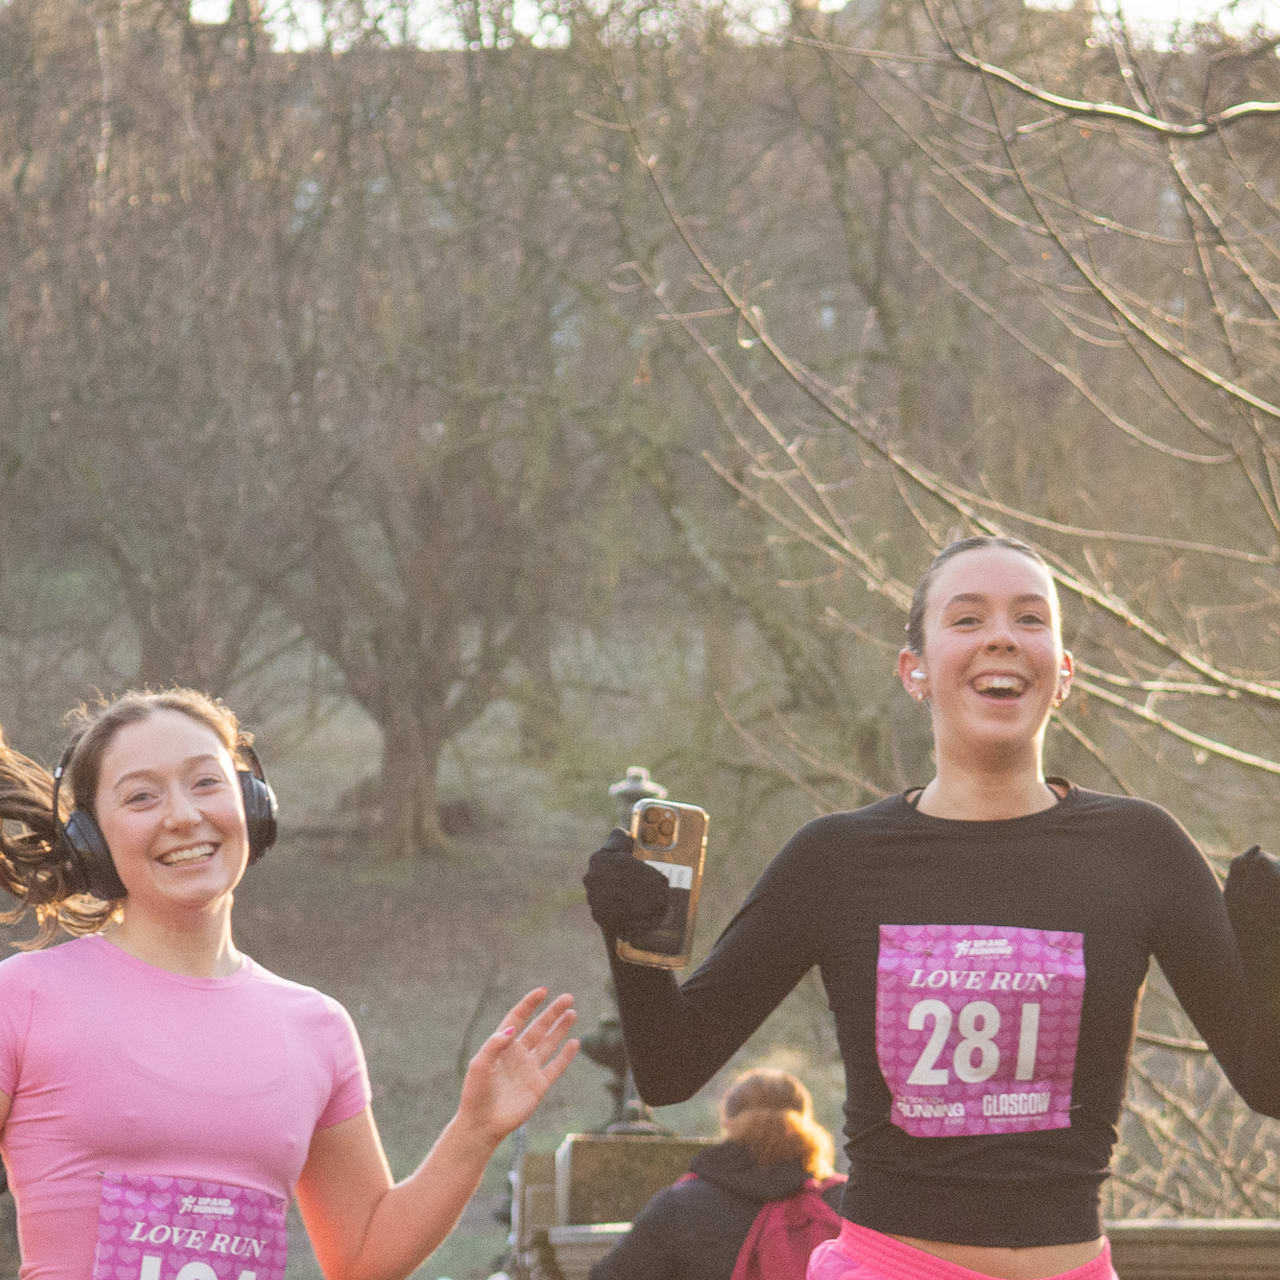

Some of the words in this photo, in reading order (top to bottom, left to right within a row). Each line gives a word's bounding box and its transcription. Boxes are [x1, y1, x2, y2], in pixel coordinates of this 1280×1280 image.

[908, 969, 986, 989] LOVE
[989, 971, 1057, 992] RUN
[906, 999, 1041, 1086] 281
[982, 1091, 1051, 1117] GLASGOW
[129, 1222, 208, 1250] LOVE
[208, 1232, 268, 1258] RUN
